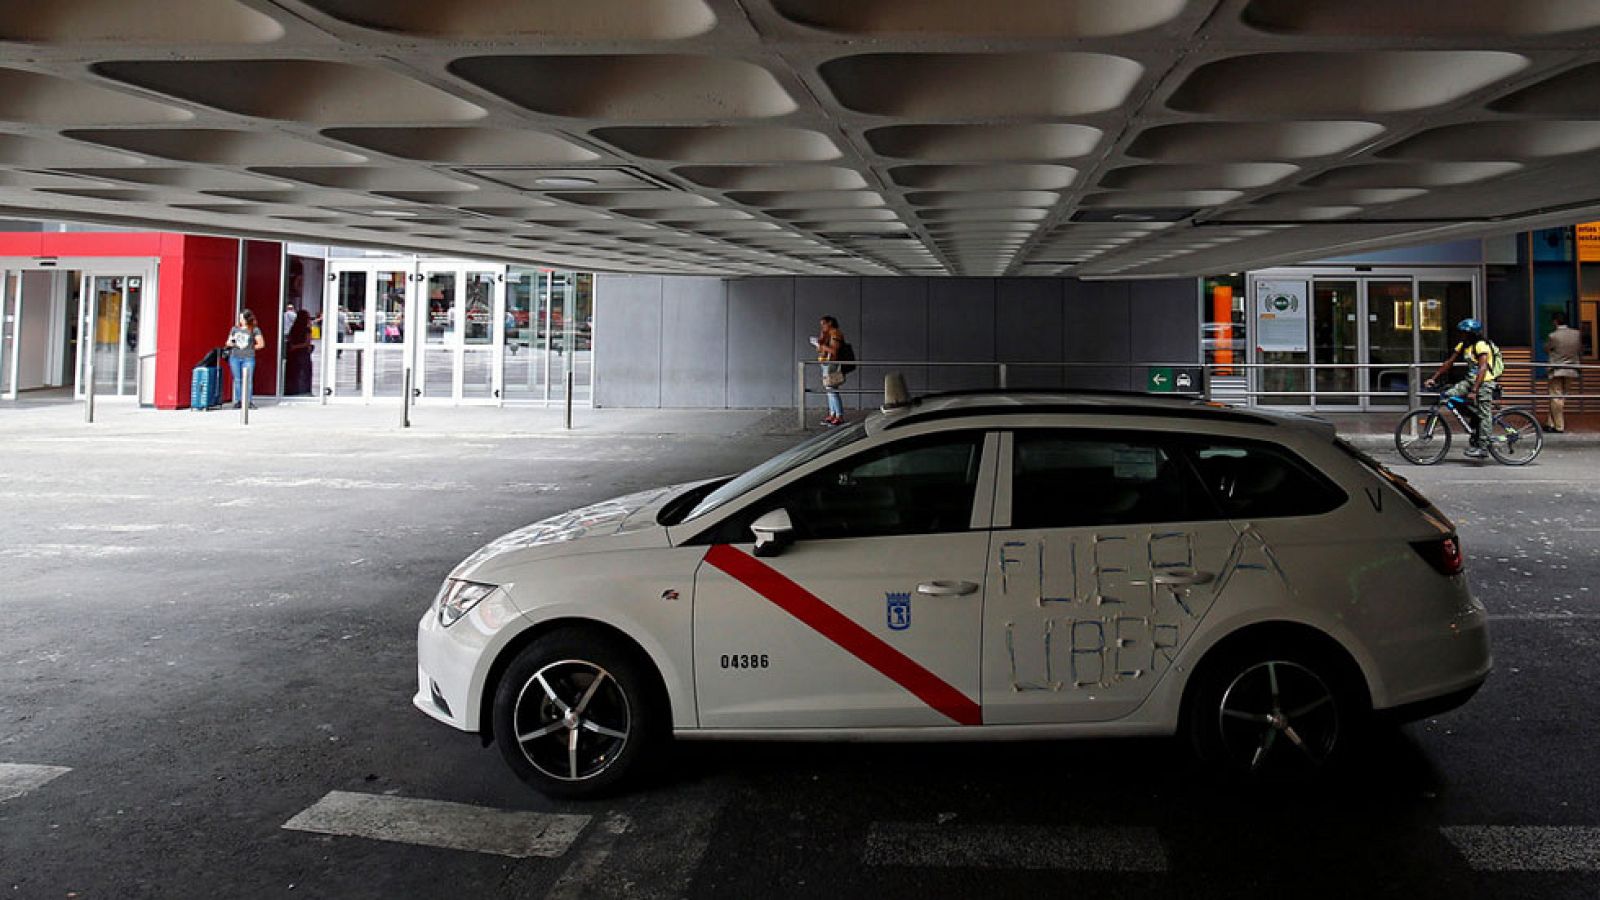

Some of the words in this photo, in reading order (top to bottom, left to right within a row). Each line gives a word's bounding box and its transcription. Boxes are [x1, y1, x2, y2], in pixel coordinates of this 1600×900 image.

[1364, 487, 1382, 514] V
[1000, 521, 1297, 617] FUERA
[720, 654, 770, 669] 04386
[1005, 614, 1179, 690] UBER
